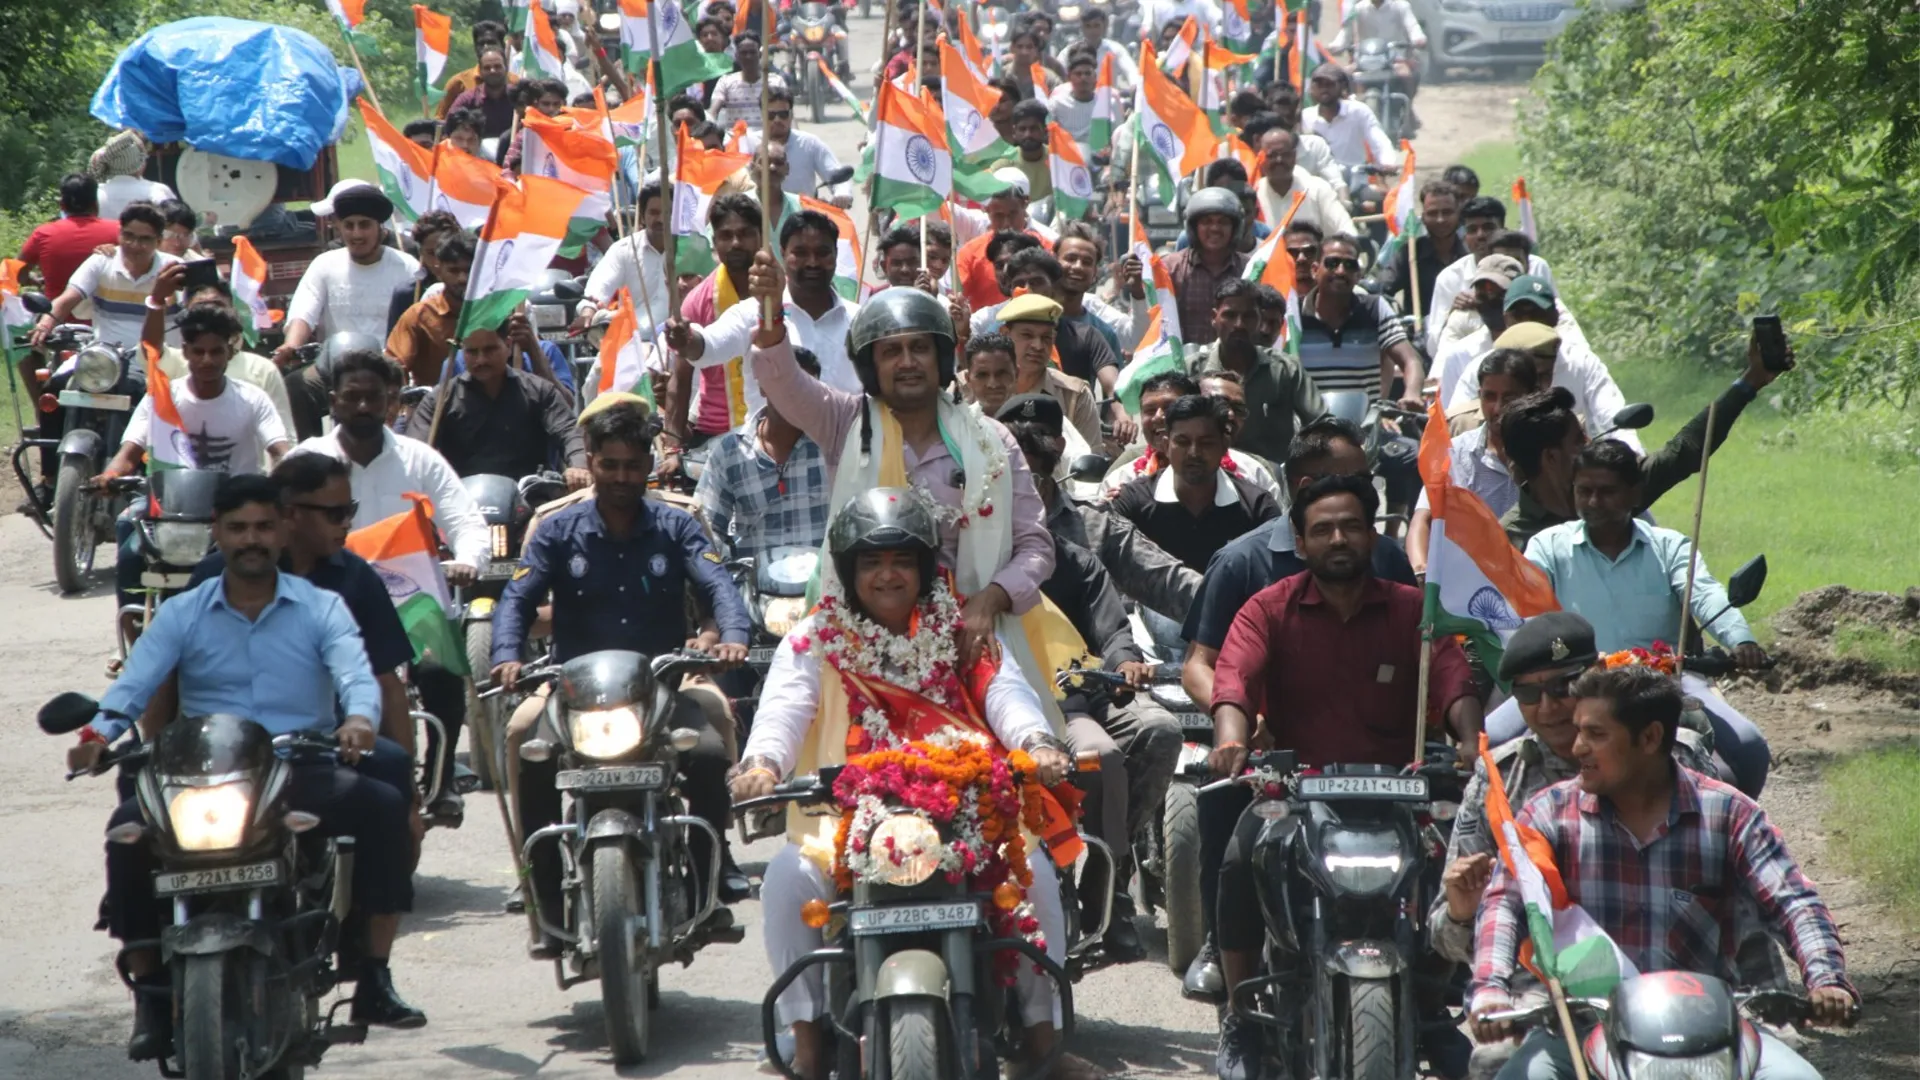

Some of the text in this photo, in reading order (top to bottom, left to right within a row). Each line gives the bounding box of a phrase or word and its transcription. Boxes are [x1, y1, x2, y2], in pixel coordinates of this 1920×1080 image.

[1318, 780, 1420, 793] UP 22AY 4166
[170, 875, 188, 889] UP
[196, 870, 232, 886] 22AX
[867, 905, 974, 926] UP 22BC 9487
